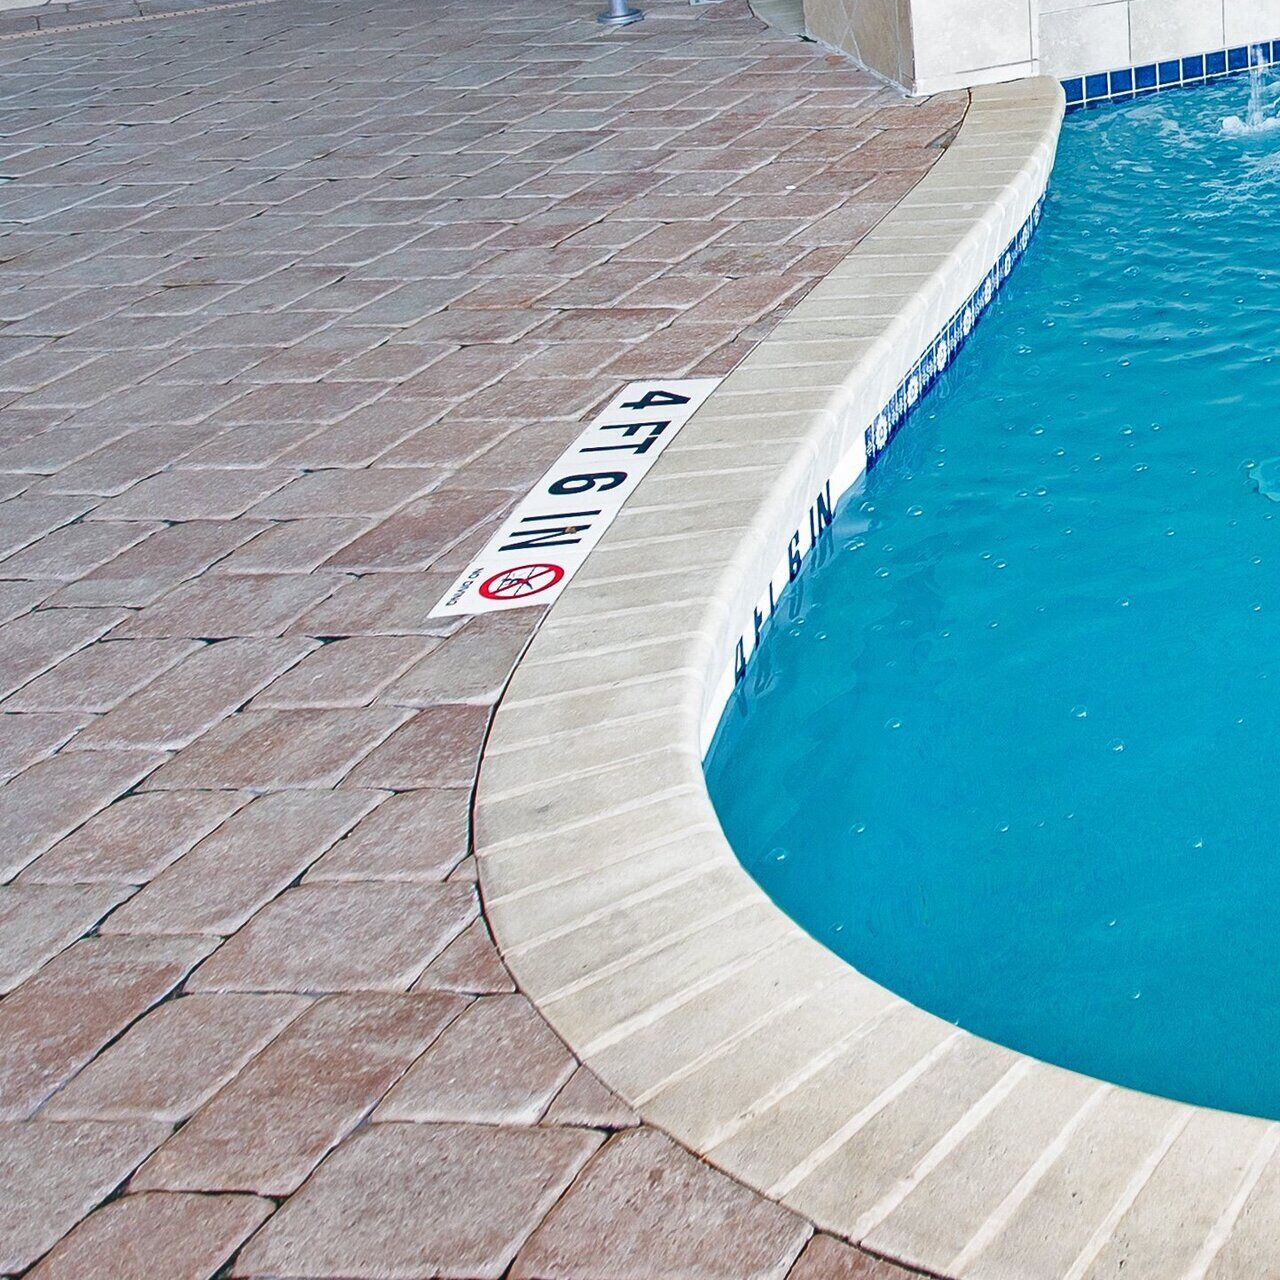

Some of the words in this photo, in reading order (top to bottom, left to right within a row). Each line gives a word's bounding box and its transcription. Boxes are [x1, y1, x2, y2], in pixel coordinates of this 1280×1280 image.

[619, 390, 691, 410] 4
[579, 420, 672, 454] FT
[548, 471, 628, 496] 6
[809, 478, 835, 549] IN
[498, 510, 602, 552] IN
